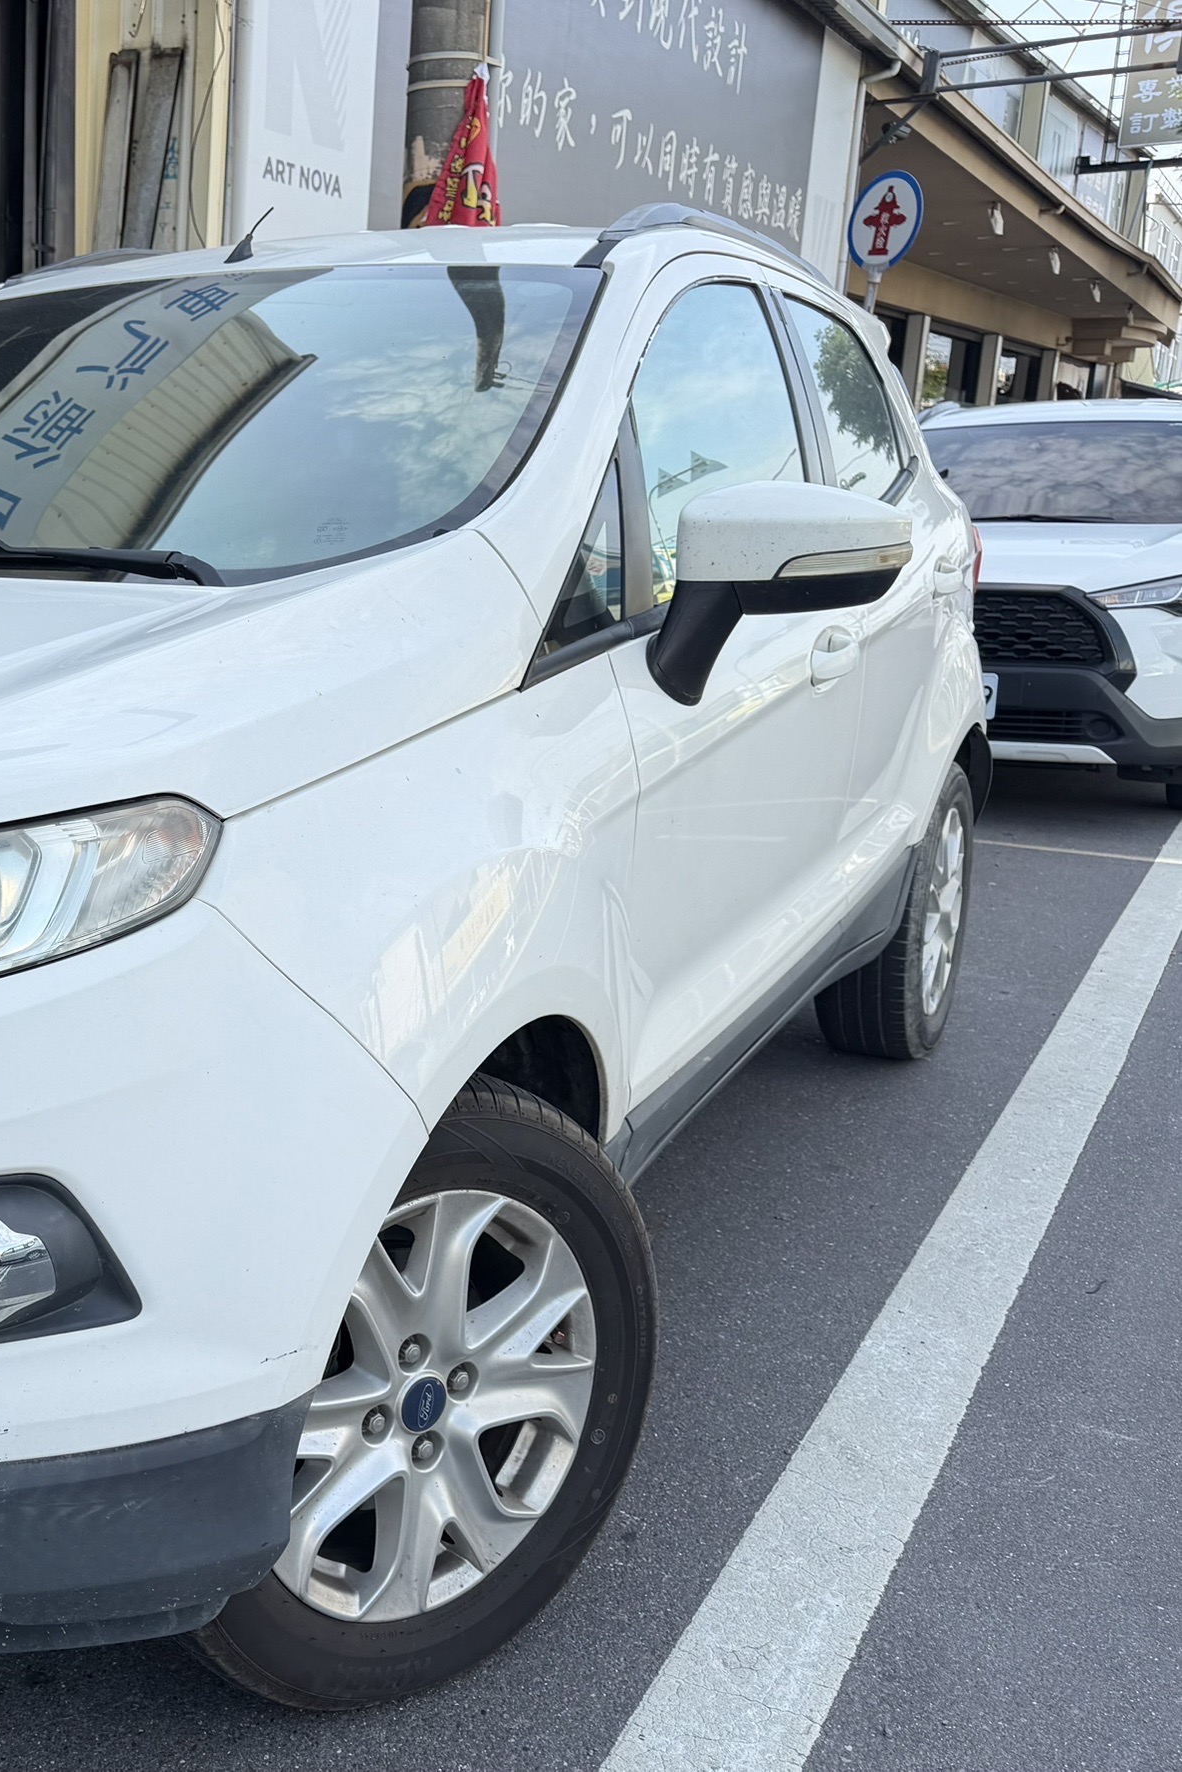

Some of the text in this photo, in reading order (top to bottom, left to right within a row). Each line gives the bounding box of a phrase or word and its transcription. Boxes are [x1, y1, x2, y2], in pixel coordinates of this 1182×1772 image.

[590, 0, 748, 95] 現代設計
[263, 156, 342, 199] ART NOVA
